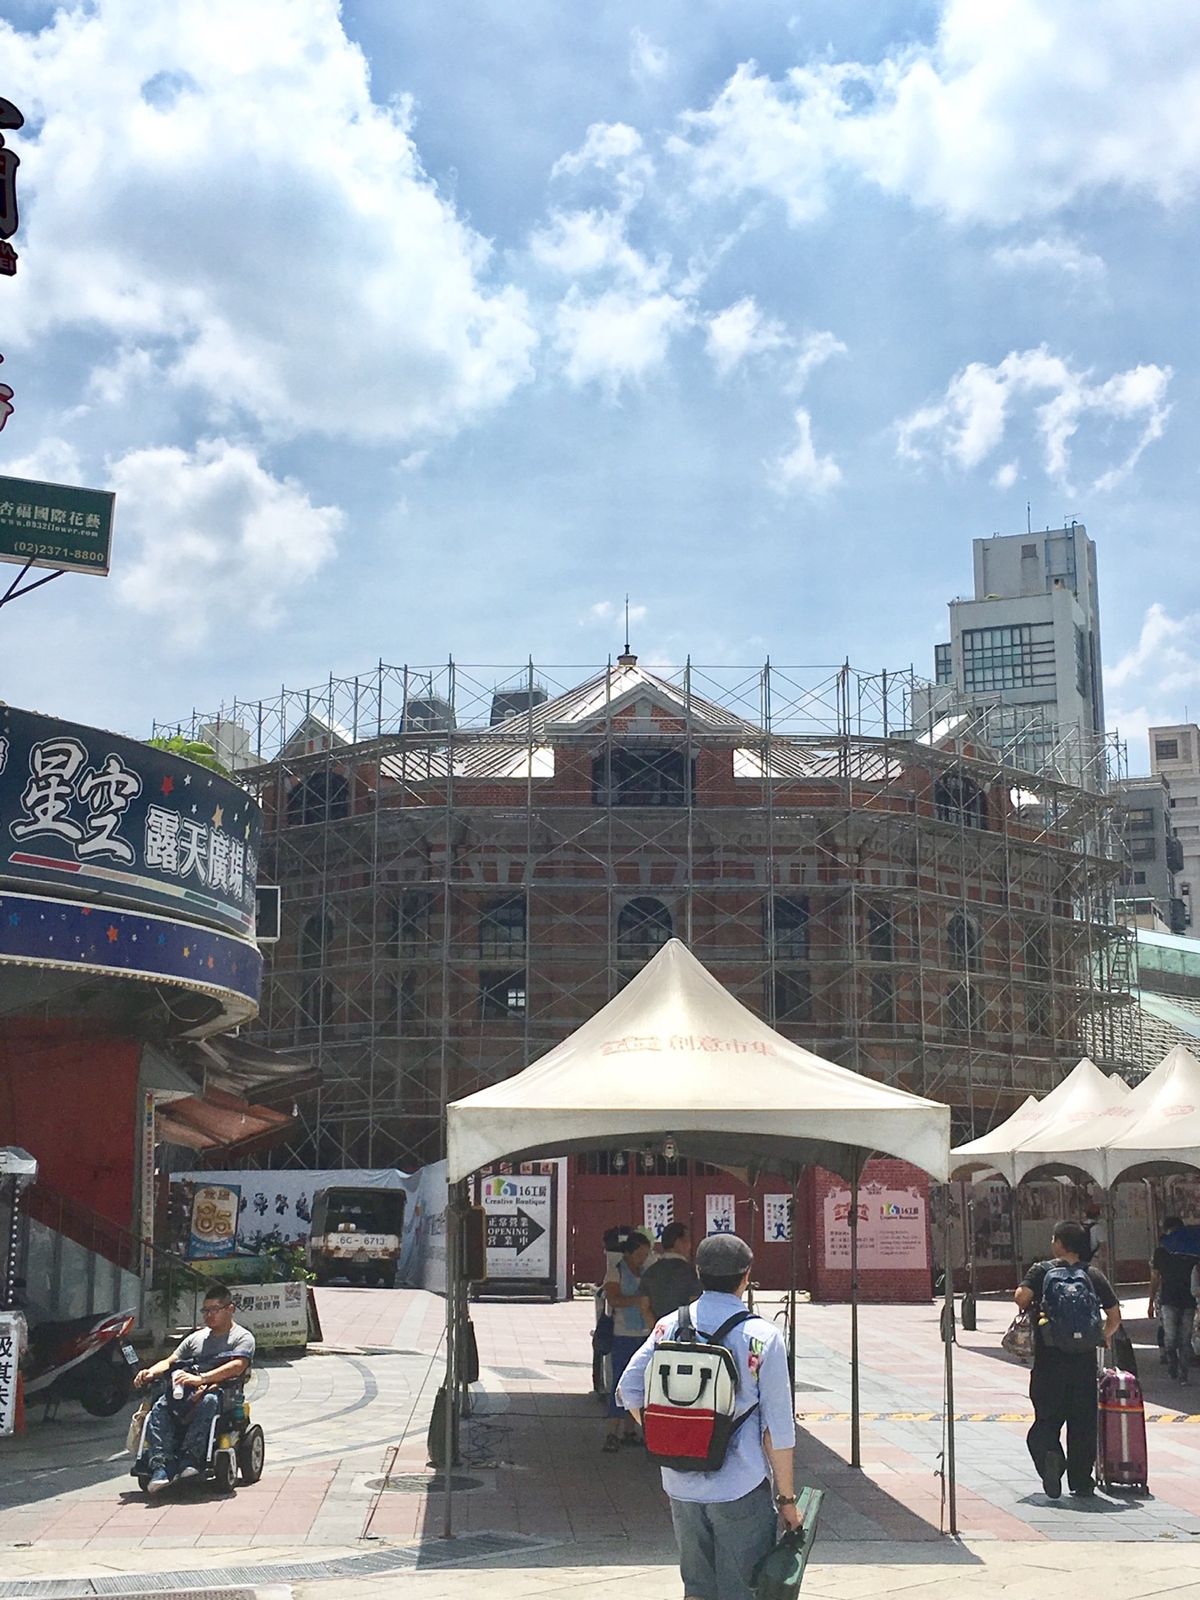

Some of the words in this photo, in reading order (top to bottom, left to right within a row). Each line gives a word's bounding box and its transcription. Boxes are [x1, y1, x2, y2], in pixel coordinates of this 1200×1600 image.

[14, 541, 105, 562] (02)2371-8800
[10, 738, 142, 865] 星空
[145, 804, 244, 899] 露天廣場
[485, 1197, 513, 1205] Creative
[487, 1227, 529, 1236] OPENING
